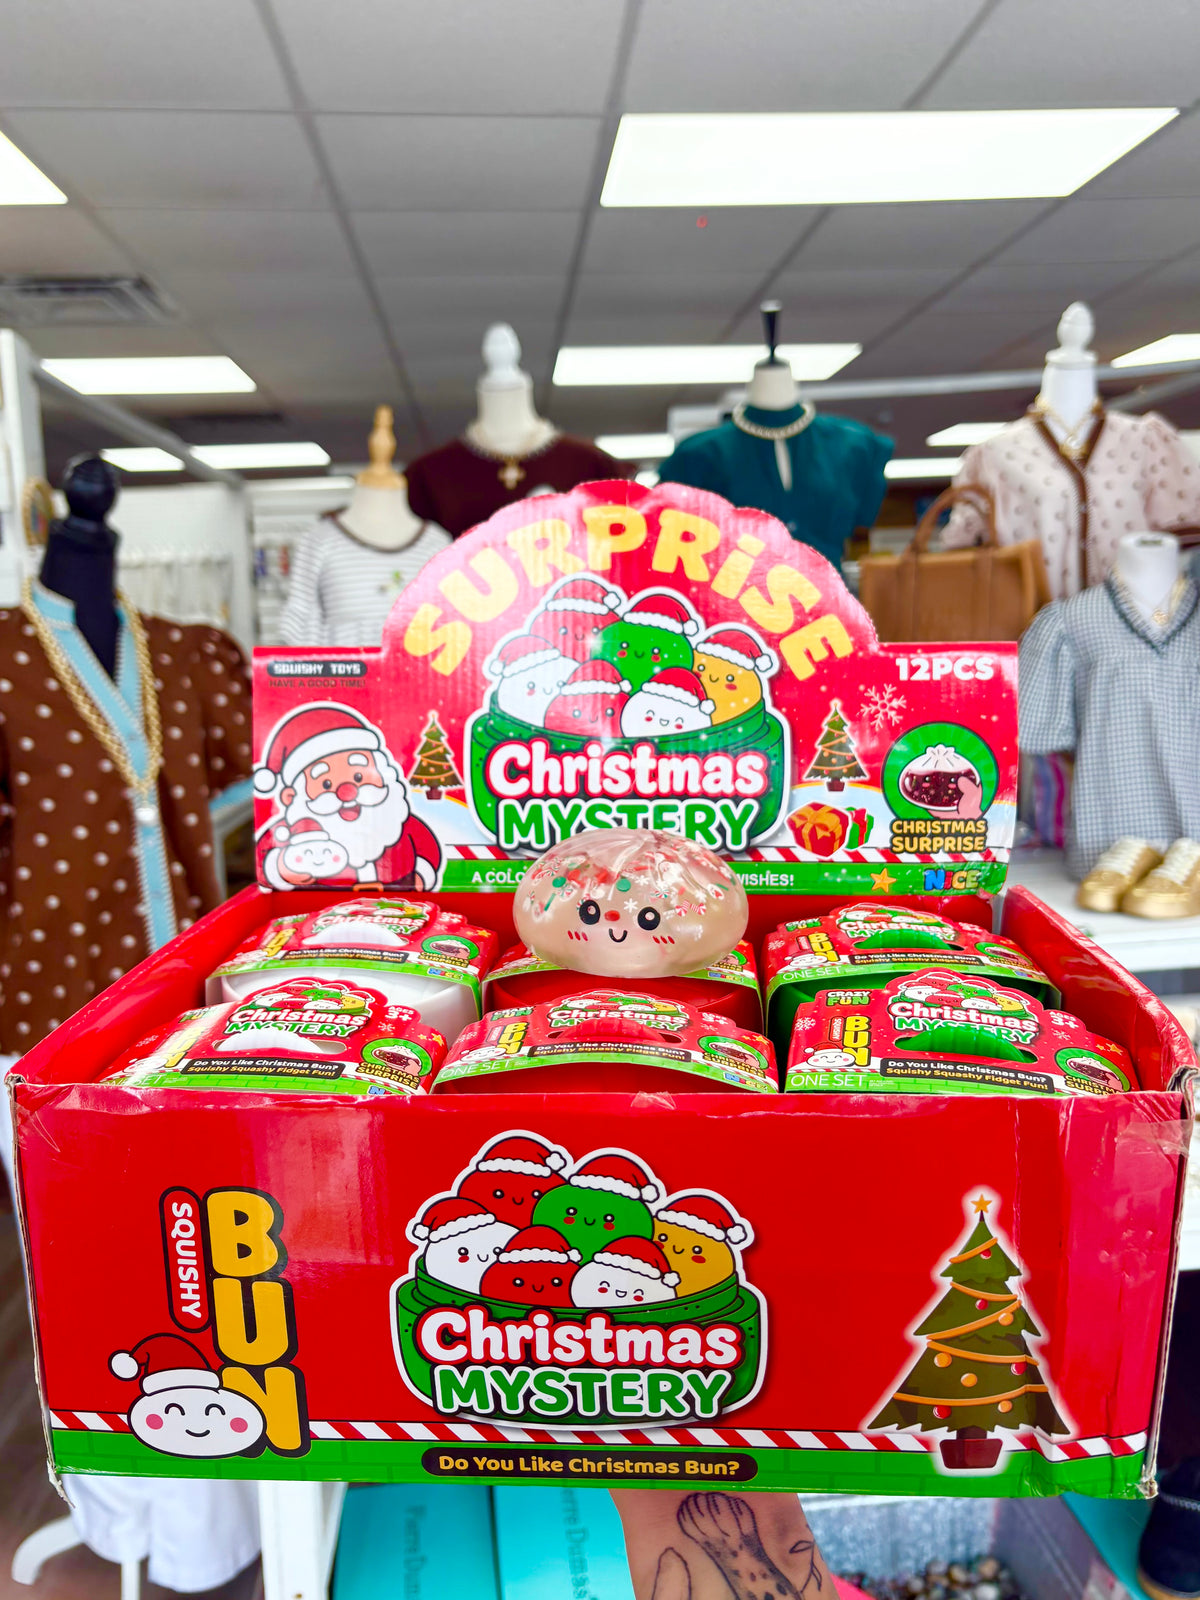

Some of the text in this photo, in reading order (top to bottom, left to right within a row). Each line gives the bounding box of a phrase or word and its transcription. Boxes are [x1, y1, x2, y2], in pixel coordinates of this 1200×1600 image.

[273, 662, 361, 675] SQUISHY TOYS
[895, 657, 994, 682] 12PCS
[269, 679, 294, 688] HAVE
[298, 679, 305, 688] A
[307, 679, 337, 688] GOOD
[486, 738, 767, 798] Christmas
[891, 820, 987, 834] CHRISTMAS
[891, 836, 986, 853] SURPRISE
[471, 871, 483, 884] A
[314, 914, 425, 927] Christmas
[838, 920, 956, 935] Christmas
[782, 969, 816, 981] ONE
[817, 966, 842, 977] SET
[826, 995, 870, 1006] FUN
[230, 1008, 368, 1027] Christmas
[385, 1010, 413, 1021] 3+
[549, 1009, 690, 1025] Christmas
[889, 1002, 1039, 1032] Christmas
[225, 1020, 359, 1037] MYSTERY
[600, 1042, 656, 1051] Christmas
[842, 1015, 871, 1067] BUN
[187, 1065, 336, 1077] Squishy Squashy Fidget Fun!
[255, 1059, 309, 1068] Christmas
[310, 1062, 339, 1071] Bun?
[359, 1061, 420, 1083] CHRISTMAS
[440, 1064, 478, 1079] ONE
[479, 1060, 514, 1072] SET
[906, 1061, 928, 1069] You
[930, 1062, 954, 1070] Like
[956, 1064, 1015, 1078] Christmas
[1017, 1073, 1047, 1083] Bun?
[356, 1066, 419, 1090] SURPRISE
[790, 1074, 830, 1087] ONE
[832, 1074, 867, 1087] SET
[886, 1067, 1049, 1090] Squishy Squashy Fidget Fun!
[171, 1201, 202, 1319] SQUISHY
[205, 1189, 305, 1452] BUN
[419, 1308, 738, 1365] Christmas
[436, 1366, 732, 1417] MYSTERY
[438, 1455, 740, 1476] Do You Like Christmas Bun?
